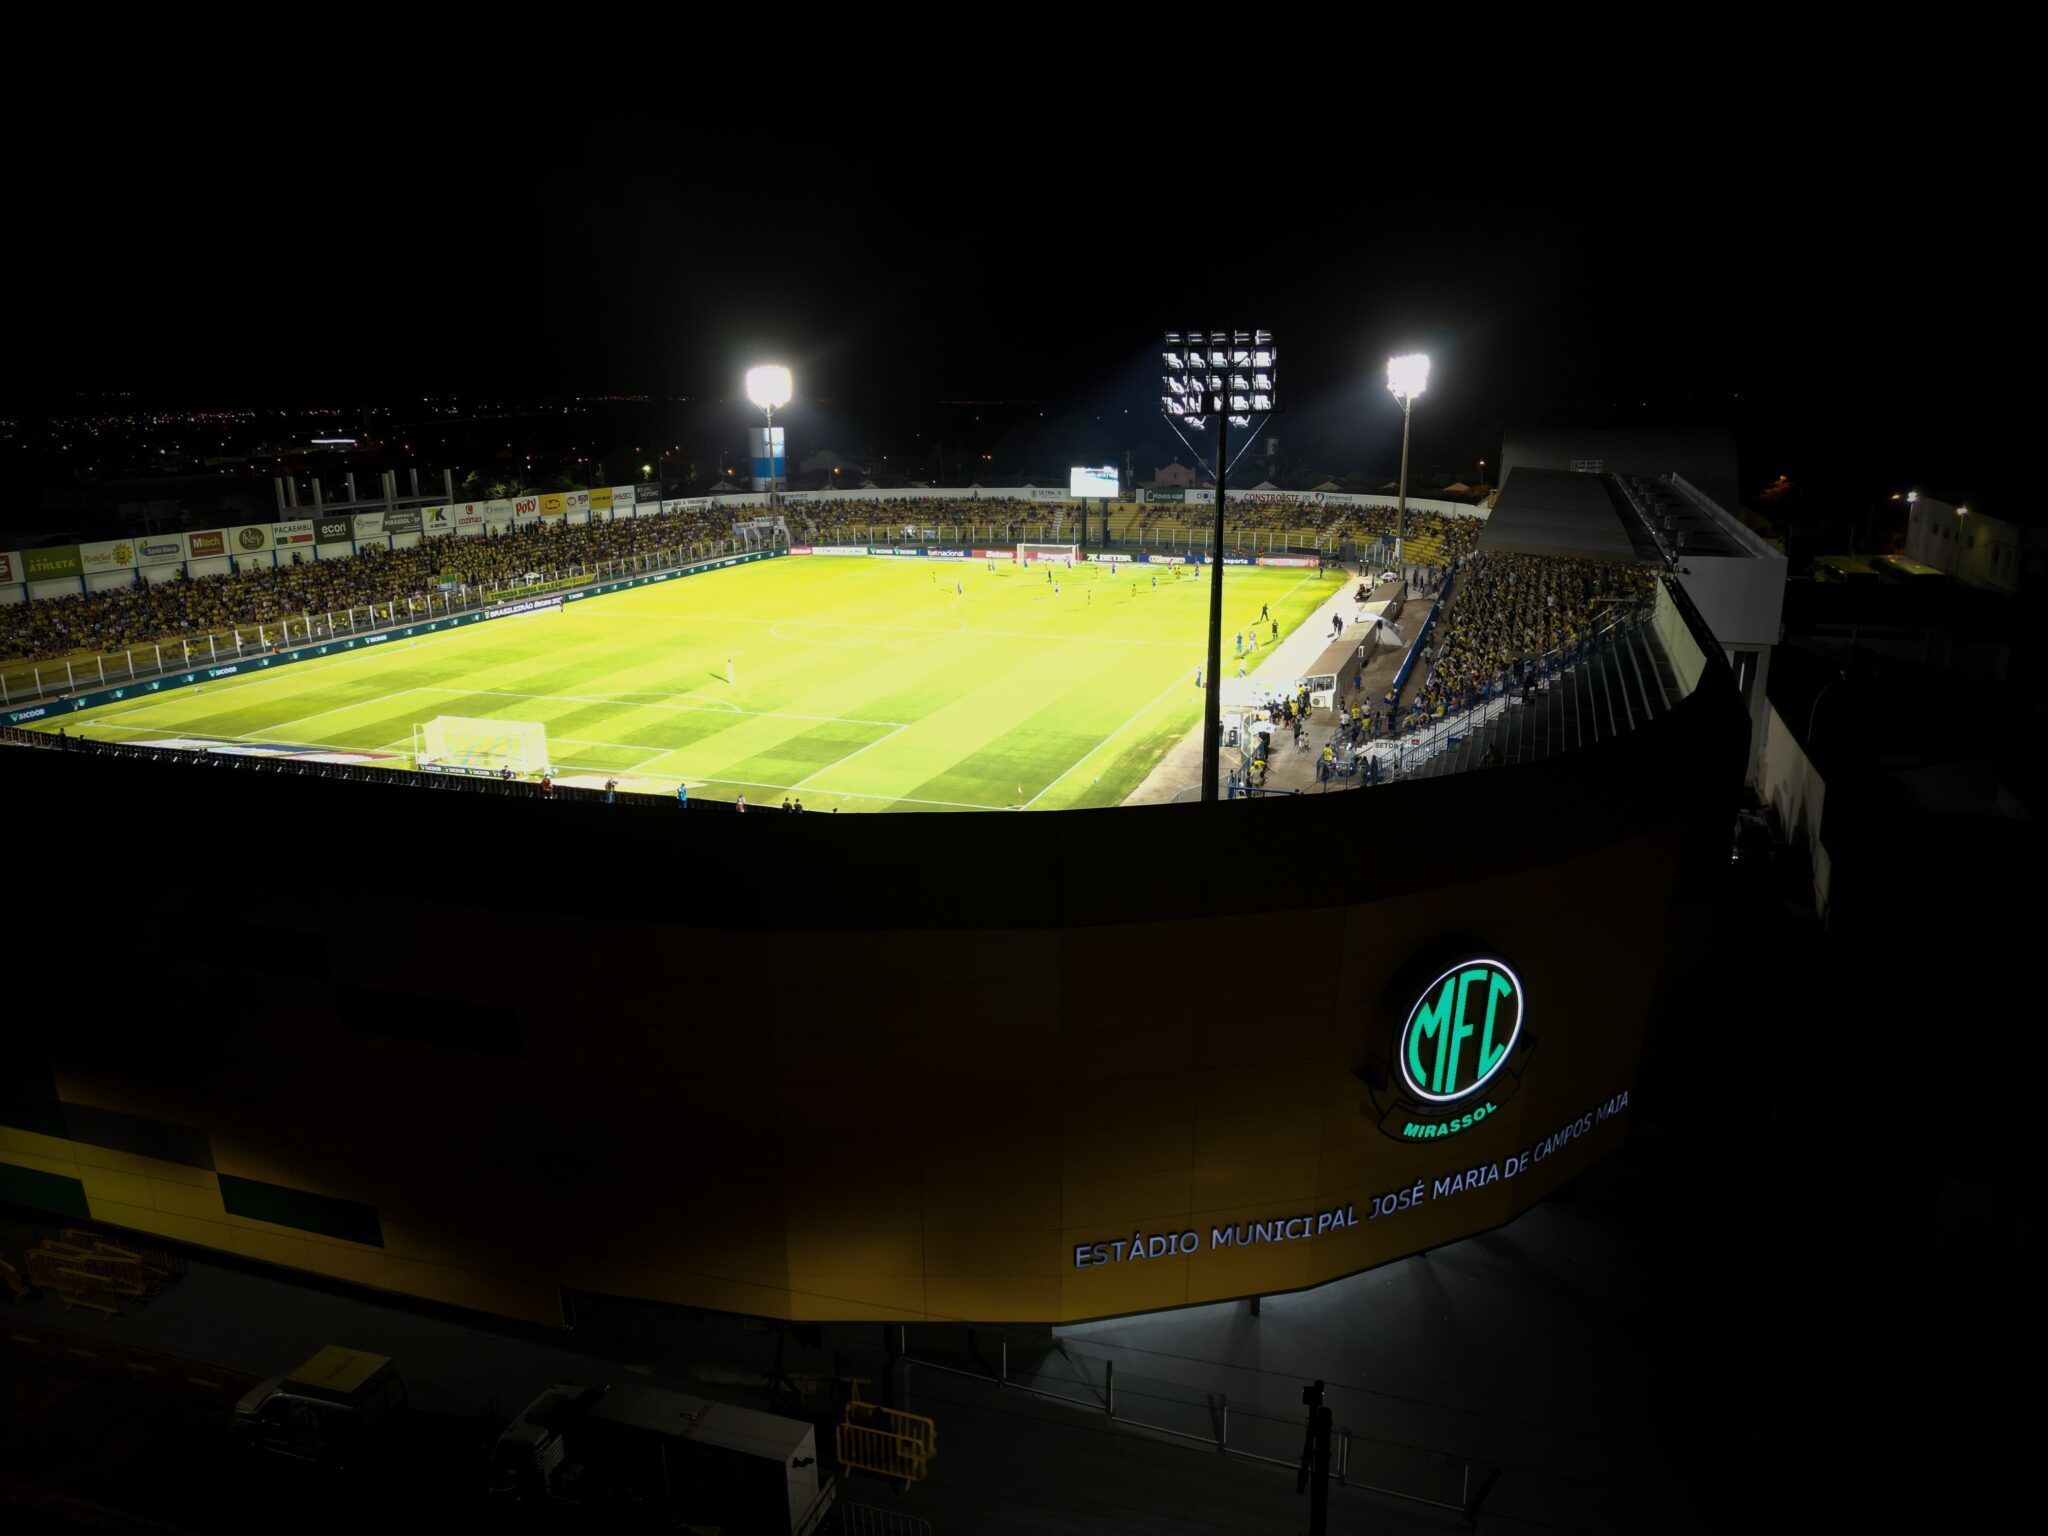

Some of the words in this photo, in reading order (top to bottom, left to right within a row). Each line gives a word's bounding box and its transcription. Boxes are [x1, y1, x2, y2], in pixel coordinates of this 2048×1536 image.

[1244, 493, 1300, 502] CONSTROSTE
[515, 498, 536, 516] Poty
[321, 521, 346, 534] ecori
[458, 517, 482, 525] cozimax
[274, 523, 313, 534] PACAEMBU
[193, 535, 221, 549] Mtech
[84, 554, 112, 565] RedeSol
[29, 560, 76, 573] ATHLETA
[490, 602, 533, 619] BRASILEIRÃO
[215, 667, 237, 677] SICOOB
[18, 708, 45, 721] SICOOB
[1408, 970, 1513, 1094] MFC
[1402, 1101, 1498, 1138] MIRASSOL
[1074, 1231, 1200, 1269] ESTÁDIO
[1211, 1205, 1359, 1250] MUNICIPAL
[1368, 1179, 1424, 1221] JOSÉ
[1432, 1163, 1499, 1201] MARIA
[1503, 1151, 1529, 1182] DE
[1533, 1111, 1593, 1164] CAMPOS
[1594, 1090, 1630, 1127] MAIA
